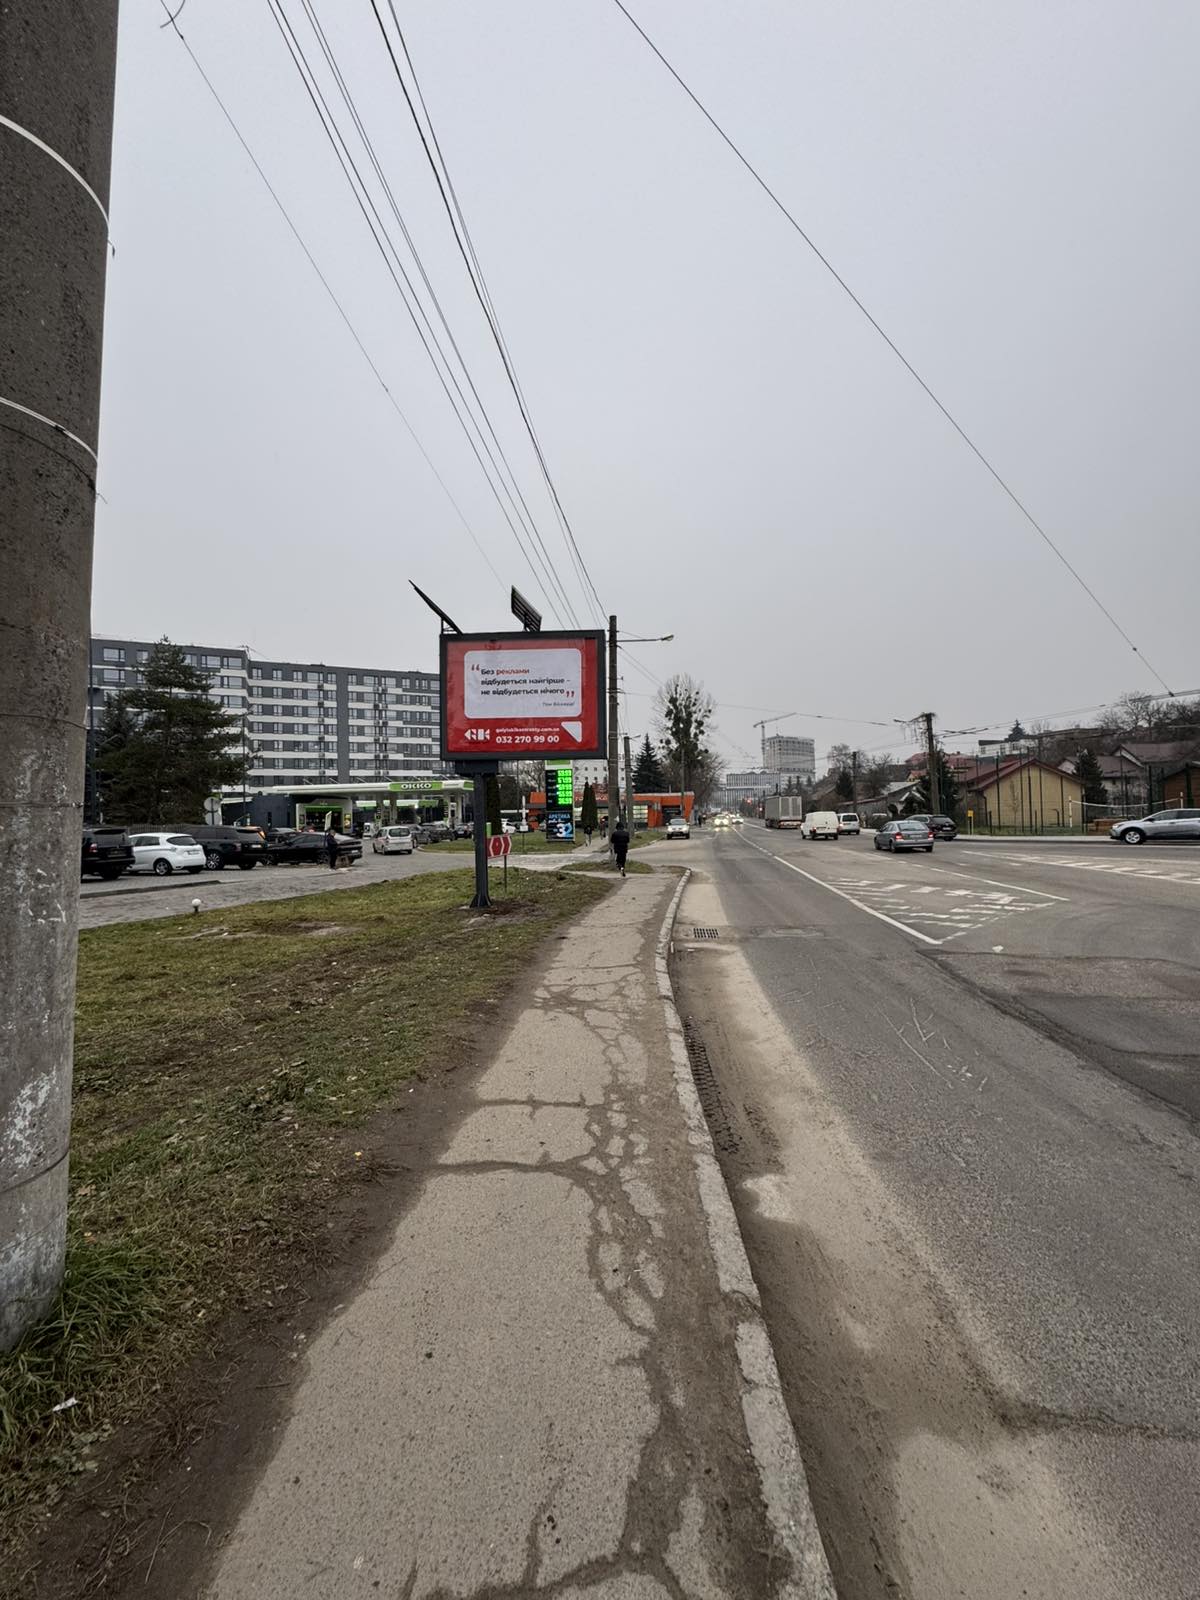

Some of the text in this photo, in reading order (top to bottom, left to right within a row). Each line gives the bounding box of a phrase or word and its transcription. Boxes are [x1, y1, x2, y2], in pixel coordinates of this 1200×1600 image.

[529, 677, 564, 685] найгірше
[492, 688, 538, 696] відбудеться
[515, 735, 531, 743] 270
[533, 735, 545, 743] 99
[547, 735, 560, 743] 00
[401, 782, 432, 790] OKKO
